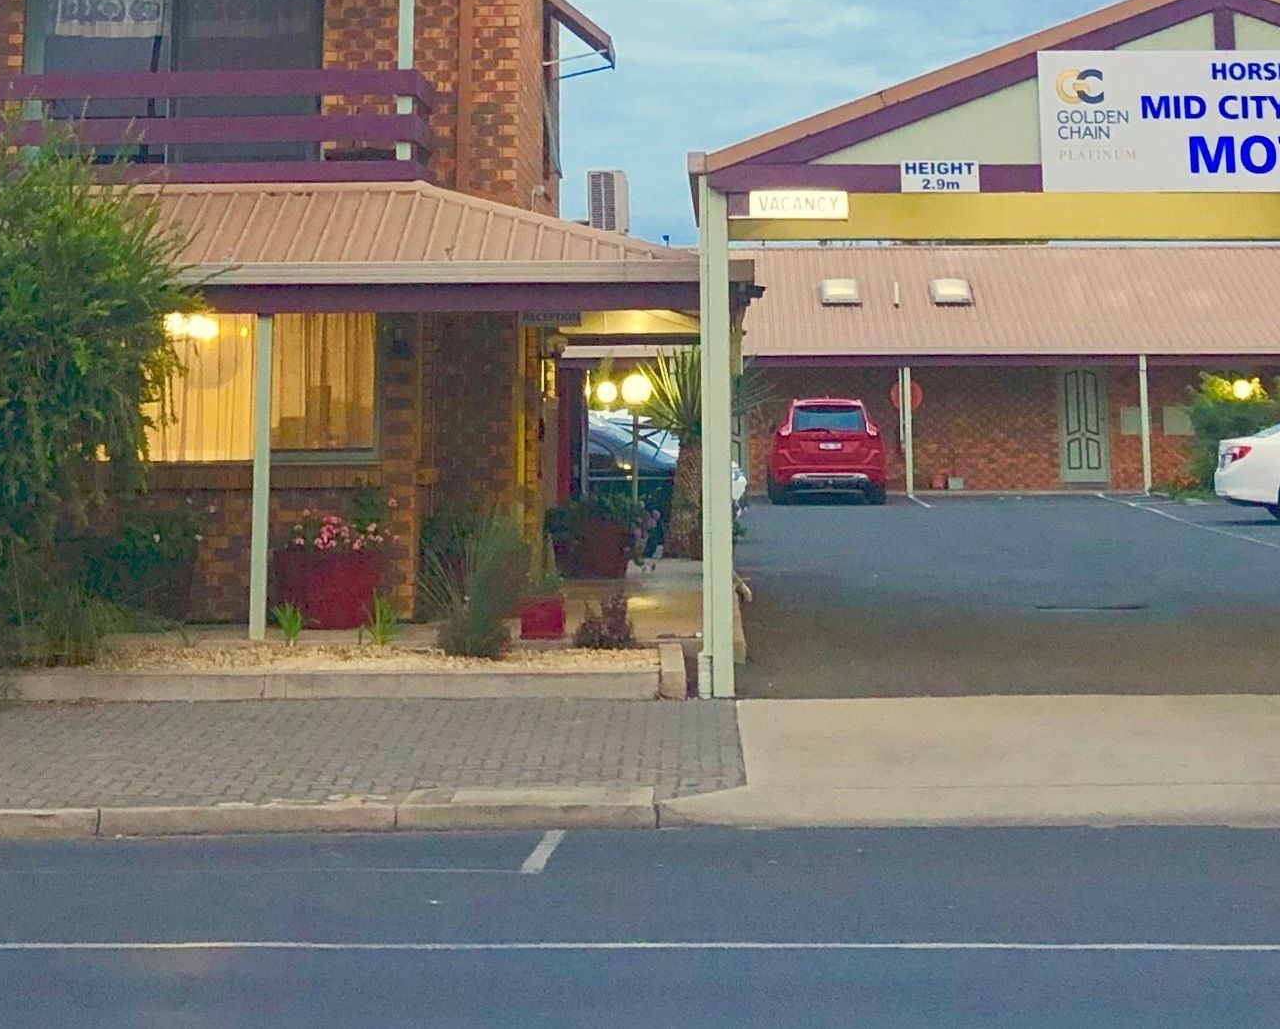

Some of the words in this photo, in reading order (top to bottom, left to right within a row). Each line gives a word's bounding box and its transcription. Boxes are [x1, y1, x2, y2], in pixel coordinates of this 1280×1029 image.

[1140, 94, 1207, 120] MID
[1056, 109, 1129, 124] GOLDEN
[1058, 125, 1111, 140] CHAIN
[1059, 149, 1137, 161] PLATINUM
[904, 162, 975, 176] HEIGHT
[921, 178, 961, 191] 2.9m
[757, 195, 840, 213] VACANCY
[522, 312, 582, 322] RECEPTION
